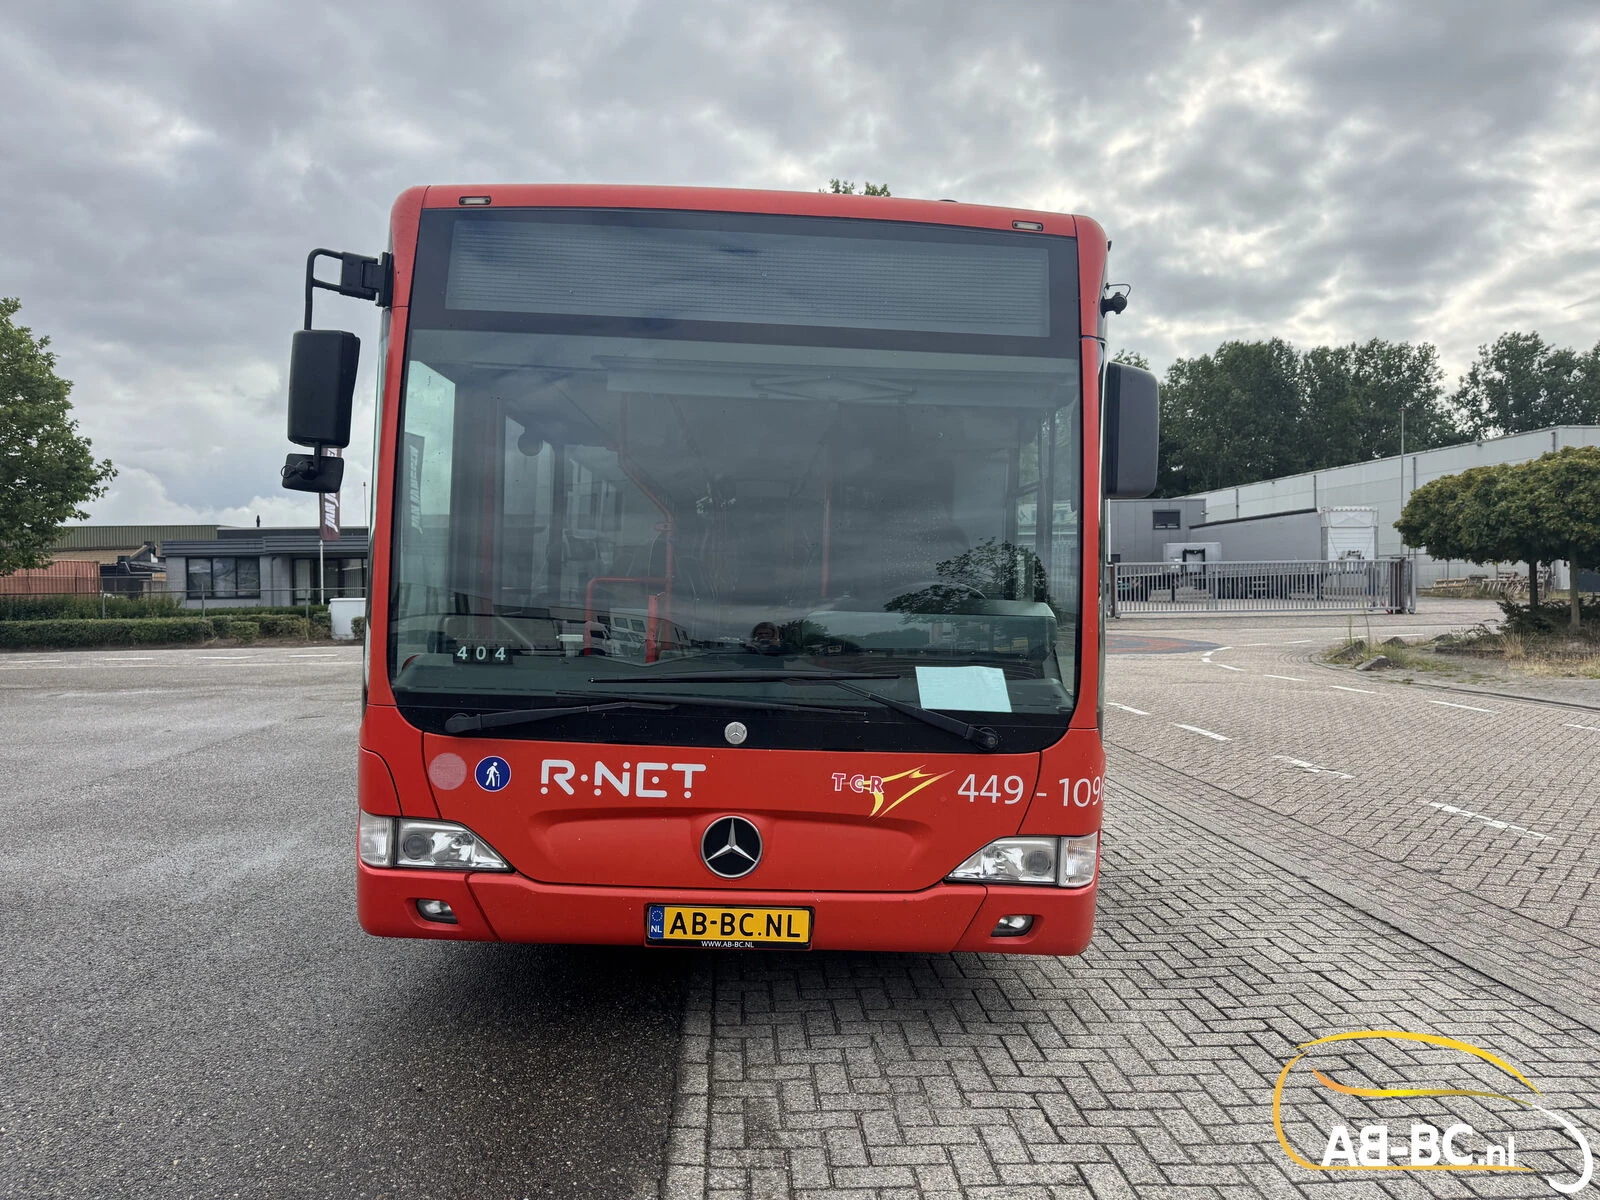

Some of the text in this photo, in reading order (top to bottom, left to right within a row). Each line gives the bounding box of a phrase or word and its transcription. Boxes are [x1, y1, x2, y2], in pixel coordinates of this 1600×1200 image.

[957, 773, 1024, 804] 449
[650, 925, 662, 933] NL
[669, 911, 801, 938] AB-BC.NL
[701, 940, 754, 949] WWW.AB-BC.NL
